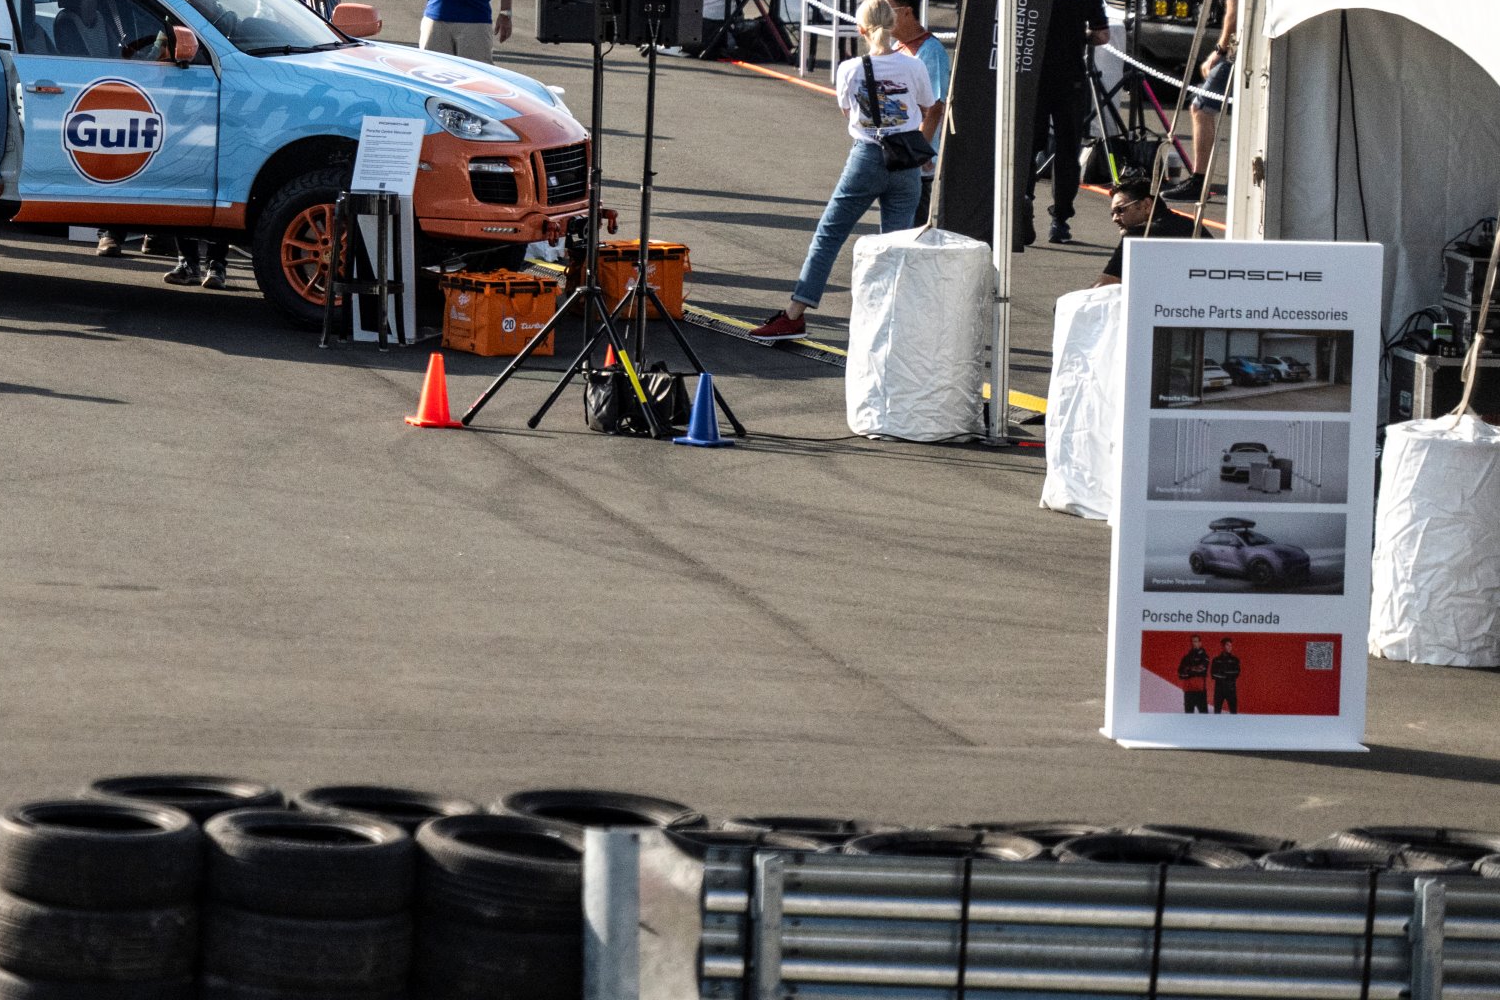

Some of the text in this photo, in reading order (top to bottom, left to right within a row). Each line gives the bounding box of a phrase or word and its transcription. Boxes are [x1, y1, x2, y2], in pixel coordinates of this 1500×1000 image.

[1021, 9, 1039, 73] TORONTO
[67, 113, 160, 149] Gulf
[1189, 269, 1323, 282] PORSCHE
[1154, 304, 1348, 321] Porsche Parts and Accessories
[504, 319, 514, 330] 20
[1142, 609, 1280, 627] Porsche Shop Canada
